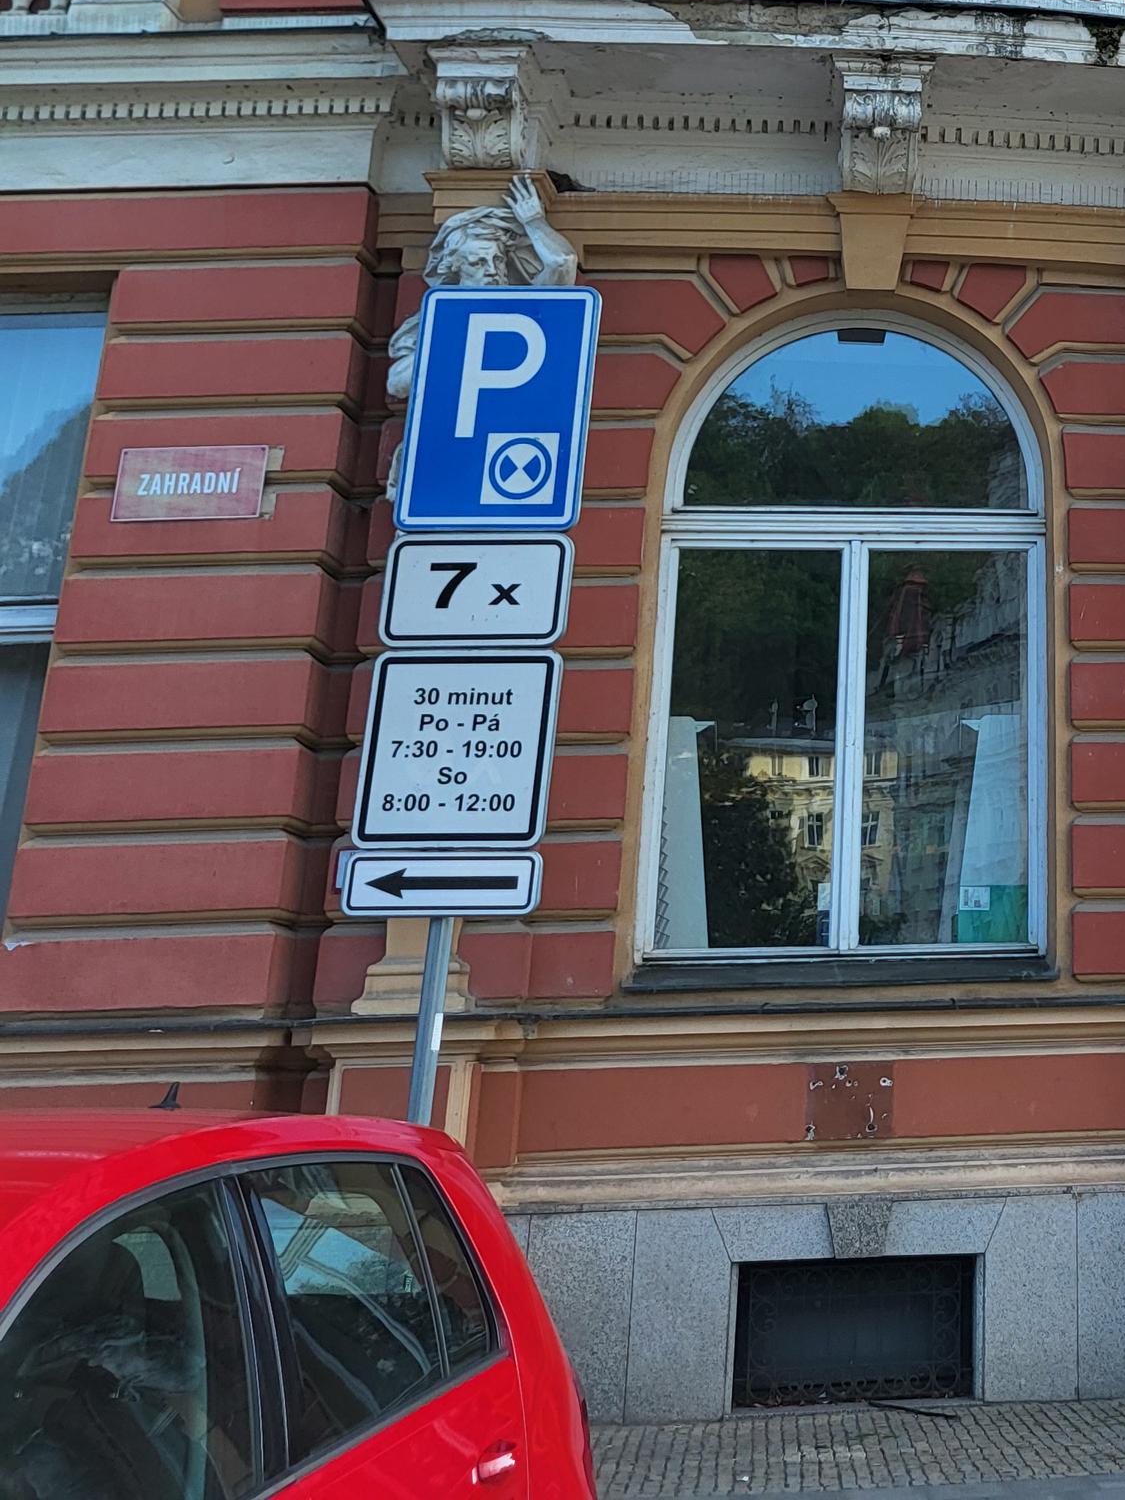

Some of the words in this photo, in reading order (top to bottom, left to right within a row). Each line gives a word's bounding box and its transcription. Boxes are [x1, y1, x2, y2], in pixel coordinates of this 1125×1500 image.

[454, 312, 546, 438] P
[137, 467, 242, 496] ZAHRADNÍ
[430, 562, 478, 609] 7
[488, 581, 522, 606] x
[413, 687, 440, 706] 30
[447, 688, 514, 706] minut
[418, 713, 450, 732] Po
[471, 713, 500, 732] Pá
[391, 740, 438, 758] 7:30
[461, 740, 522, 758] 19:00
[437, 766, 468, 785] So
[382, 793, 430, 812] 8:00
[454, 793, 516, 812] 12:00
